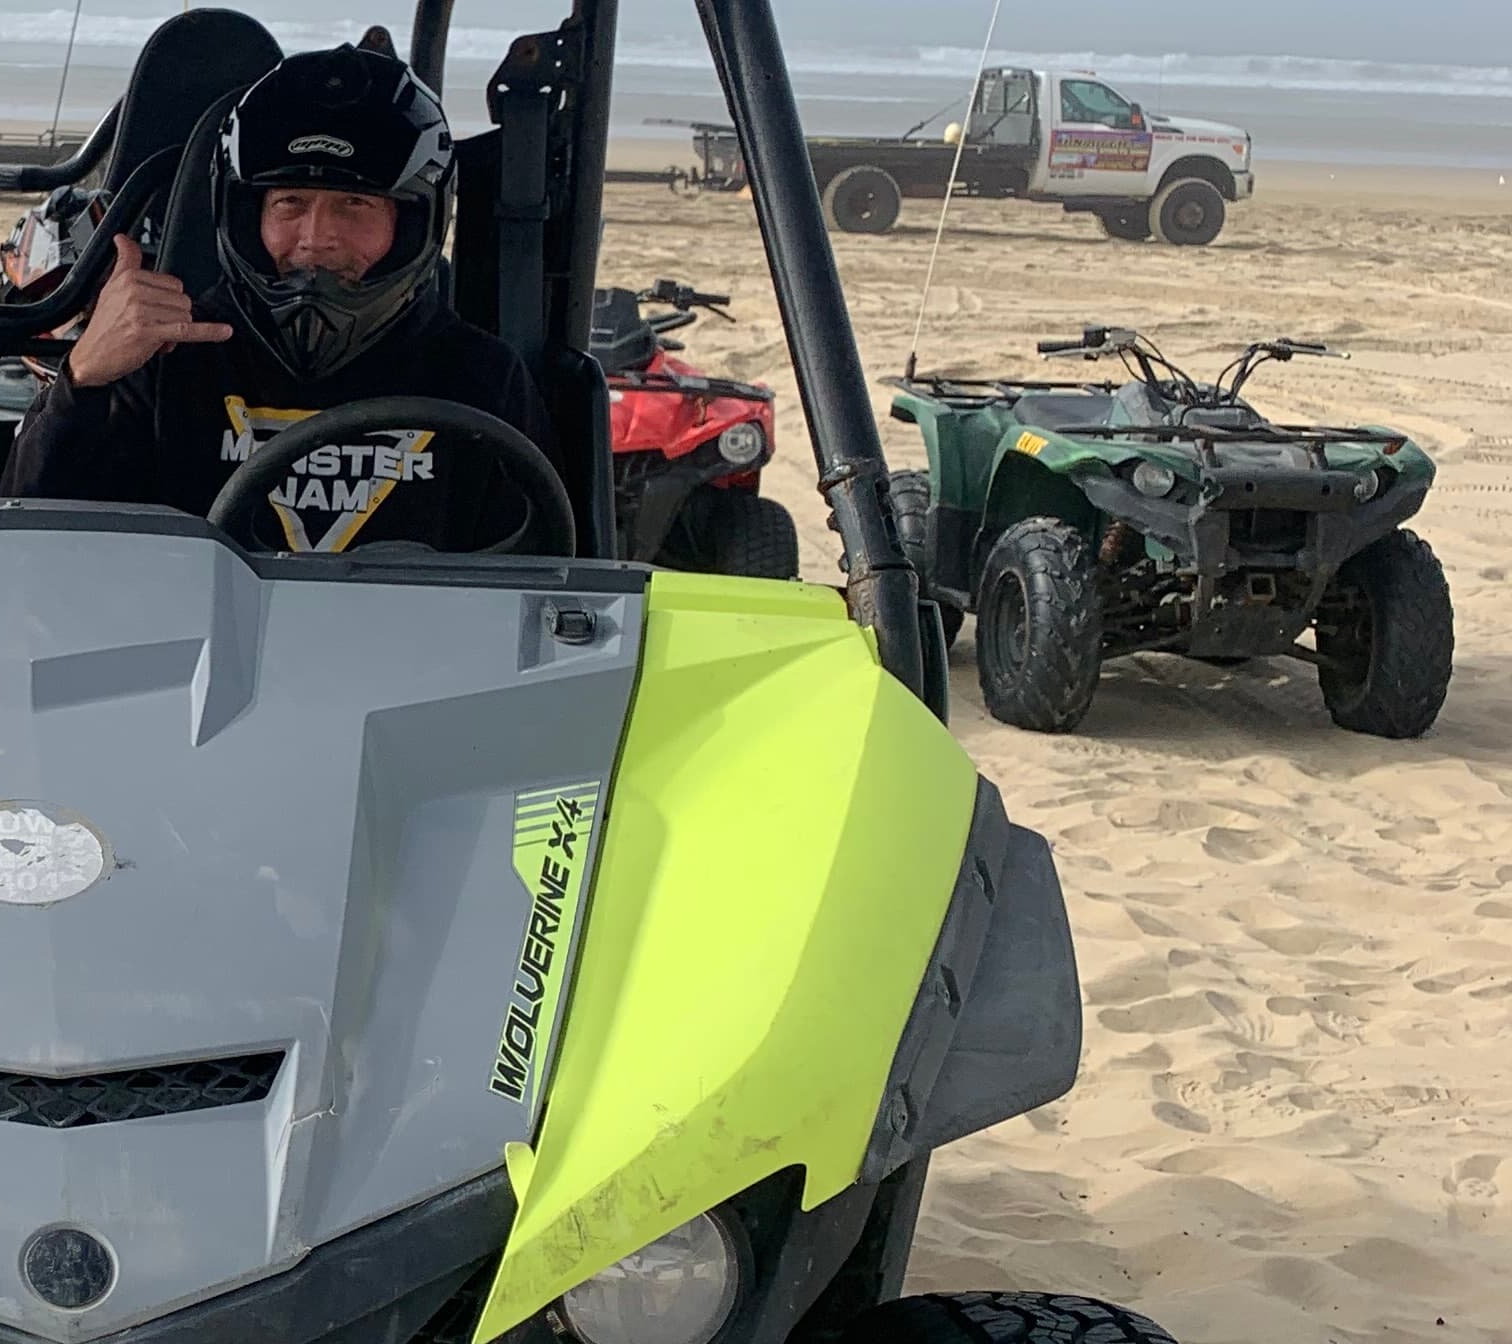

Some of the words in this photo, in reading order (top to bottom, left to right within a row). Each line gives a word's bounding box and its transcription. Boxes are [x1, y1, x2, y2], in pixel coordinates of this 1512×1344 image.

[220, 429, 435, 481] MSTER
[271, 476, 370, 513] JAM
[489, 856, 571, 1103] WOLVERINE
[548, 794, 583, 861] X4
